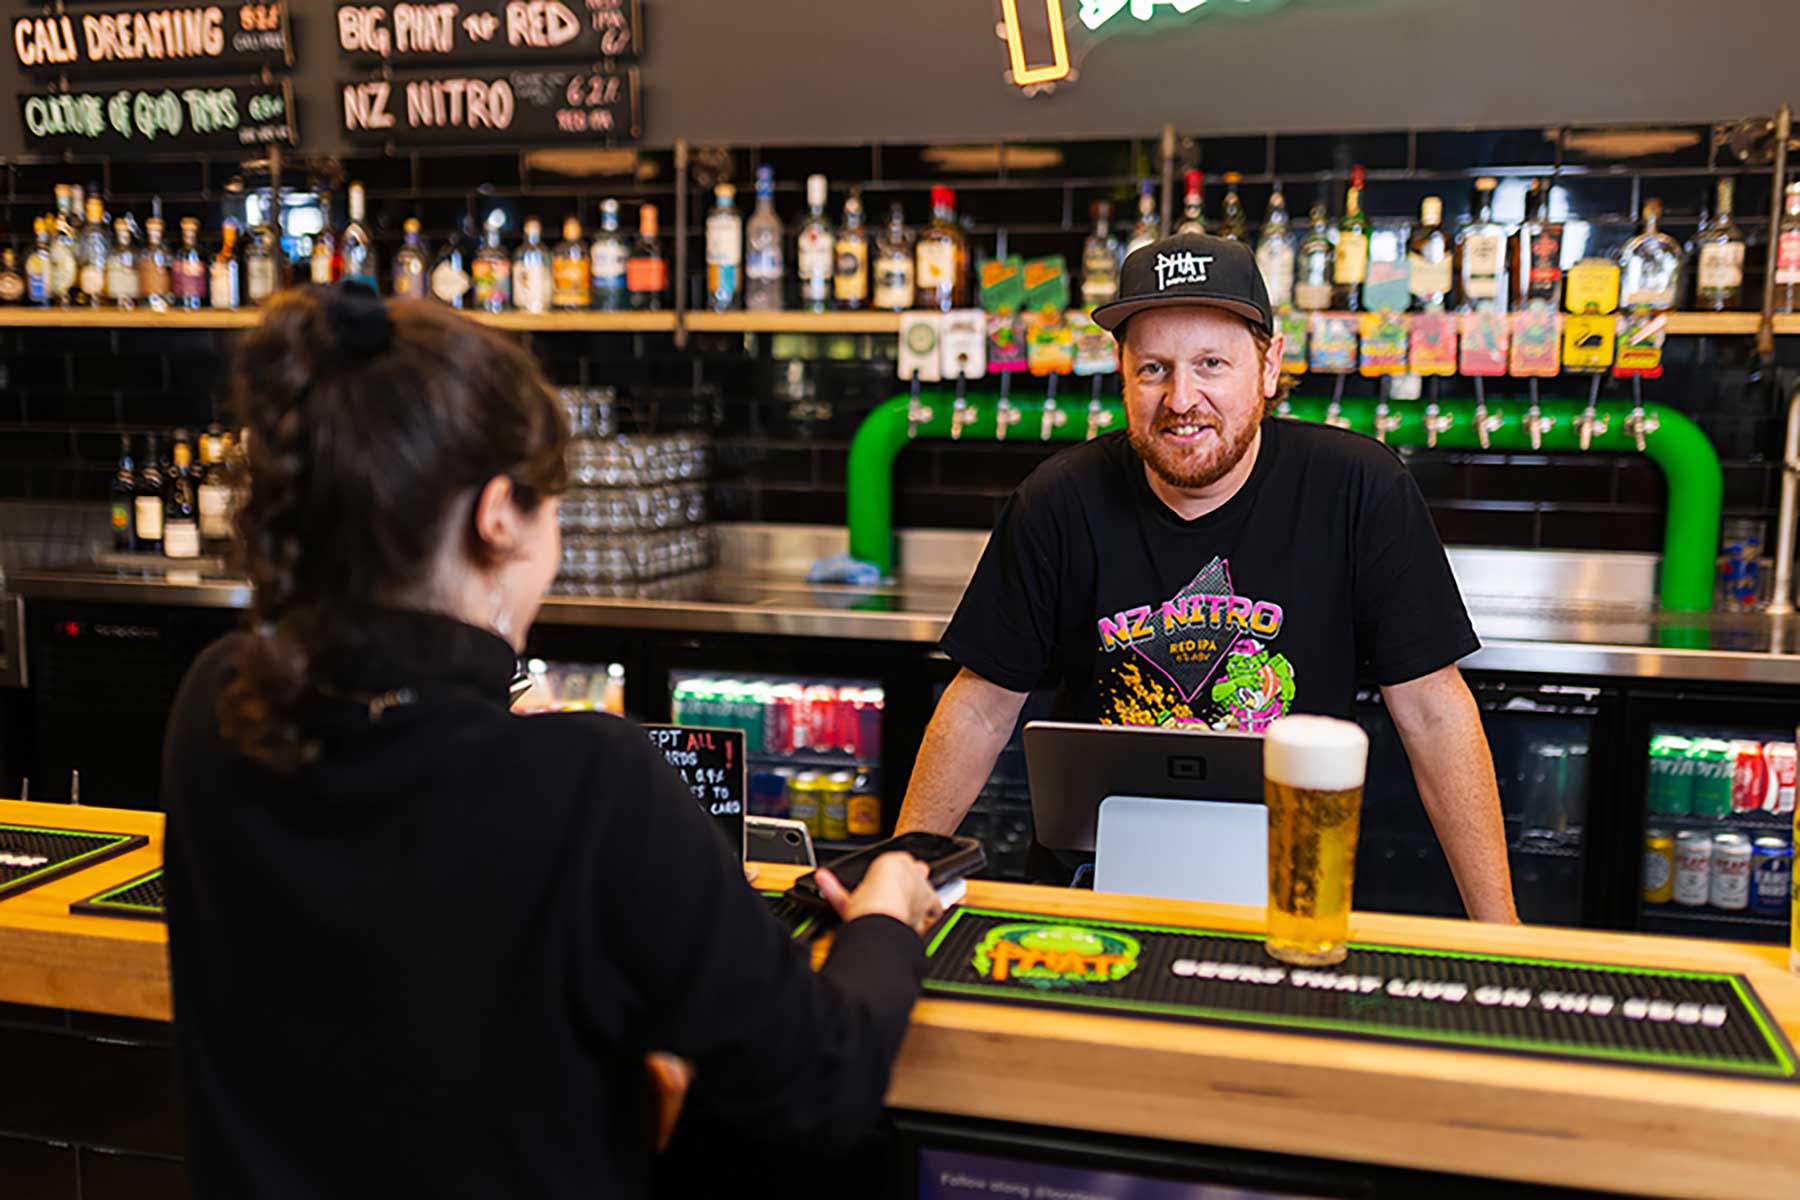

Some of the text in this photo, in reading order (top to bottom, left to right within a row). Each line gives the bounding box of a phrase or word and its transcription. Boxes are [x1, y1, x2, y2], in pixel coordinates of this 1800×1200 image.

[15, 6, 224, 65] CALI DREAMING
[338, 6, 391, 57] BIG
[393, 3, 459, 53] PHAT
[505, 0, 580, 47] RED
[344, 81, 395, 130] NZ
[406, 78, 514, 129] NITRO
[1154, 251, 1213, 291] PHAT
[1098, 594, 1283, 653] NZ NITRO
[687, 732, 716, 751] ALL
[712, 786, 729, 799] TO
[1474, 987, 1532, 1008] ON
